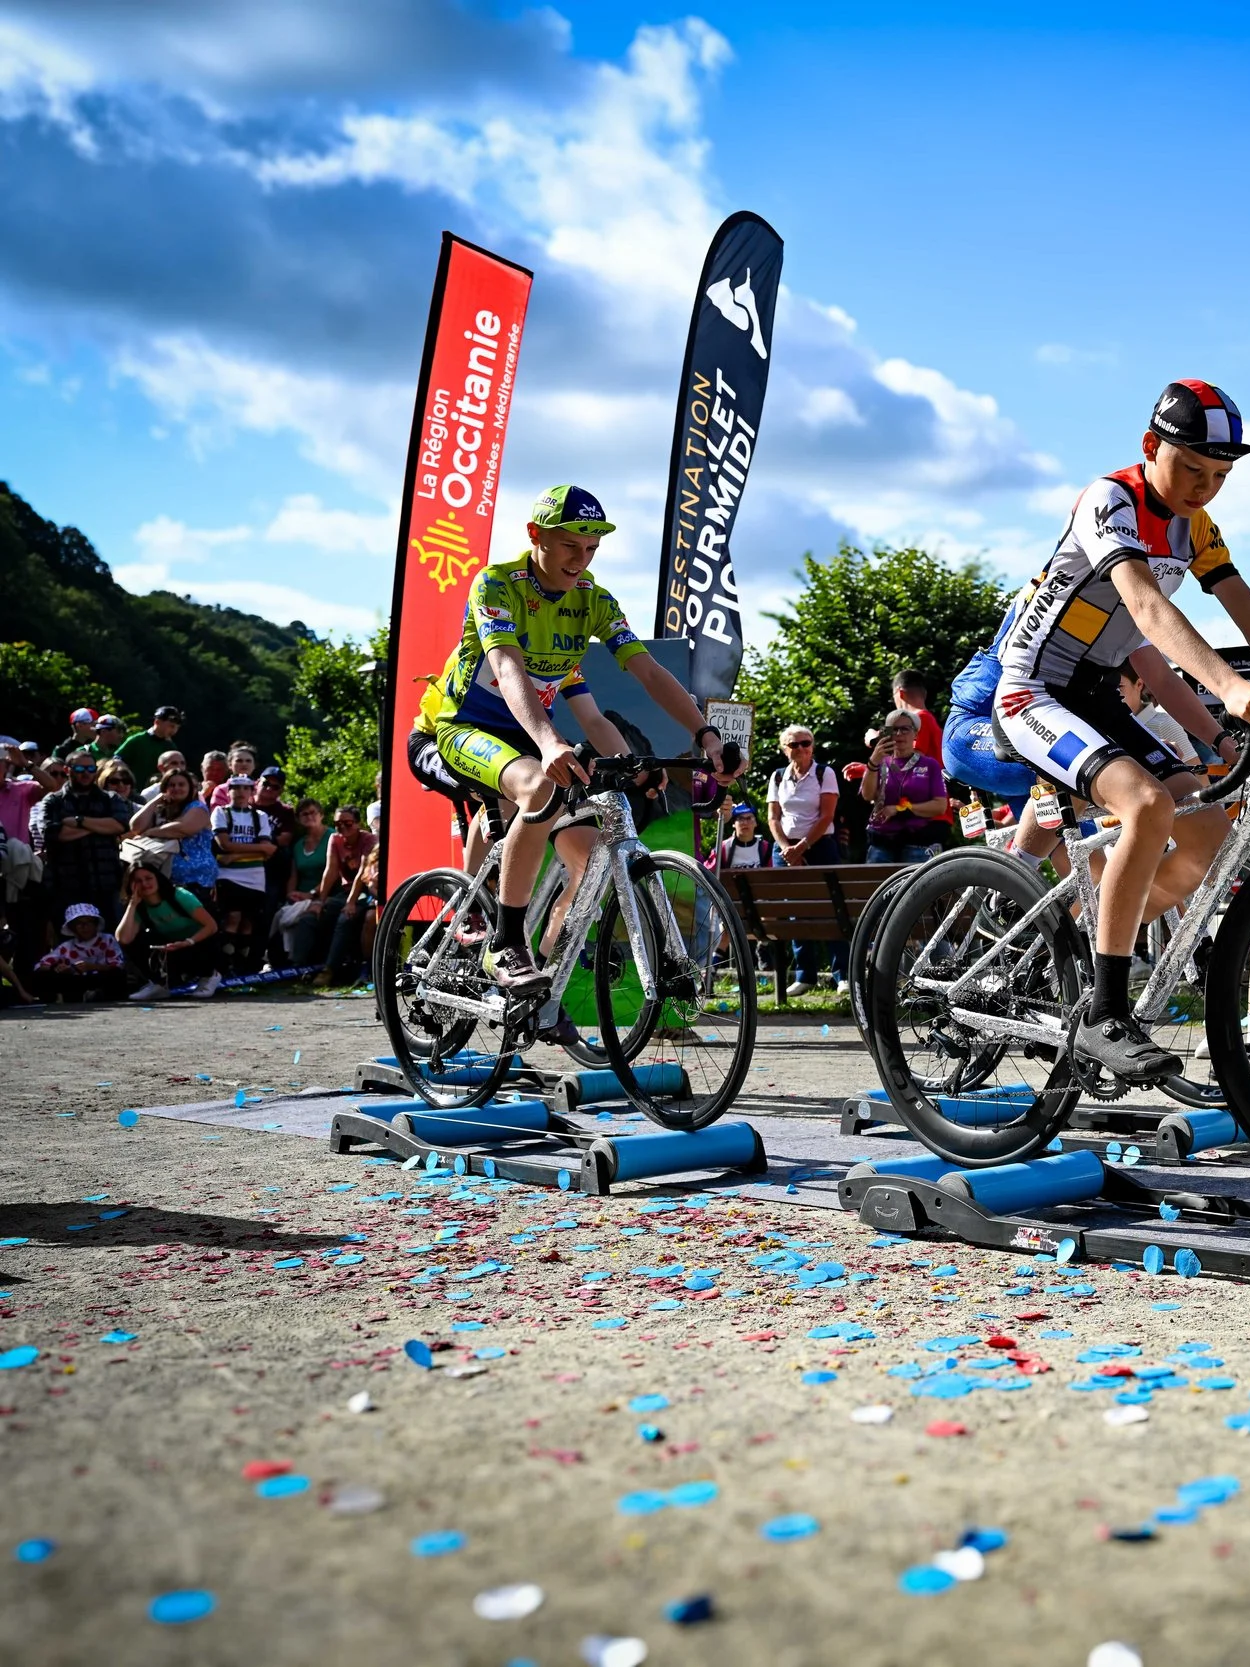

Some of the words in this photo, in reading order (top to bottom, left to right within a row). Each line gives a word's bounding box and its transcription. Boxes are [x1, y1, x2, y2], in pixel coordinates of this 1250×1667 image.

[441, 309, 501, 508] Occitanie
[476, 441, 500, 517] Pyrénées
[493, 323, 520, 430] Méditerranée
[421, 387, 451, 469] Région
[1154, 414, 1180, 435] Wonder
[417, 474, 438, 500] La
[665, 371, 711, 633] DESTINATION
[1095, 524, 1141, 542] WONDE
[1011, 570, 1075, 650] WONDER
[552, 633, 586, 651] ADR
[709, 714, 730, 731] COL
[731, 718, 746, 732] DU
[1020, 708, 1058, 746] WONDER
[467, 736, 502, 763] ADR
[1035, 807, 1060, 818] HINAULT
[1036, 800, 1055, 809] BERNARD
